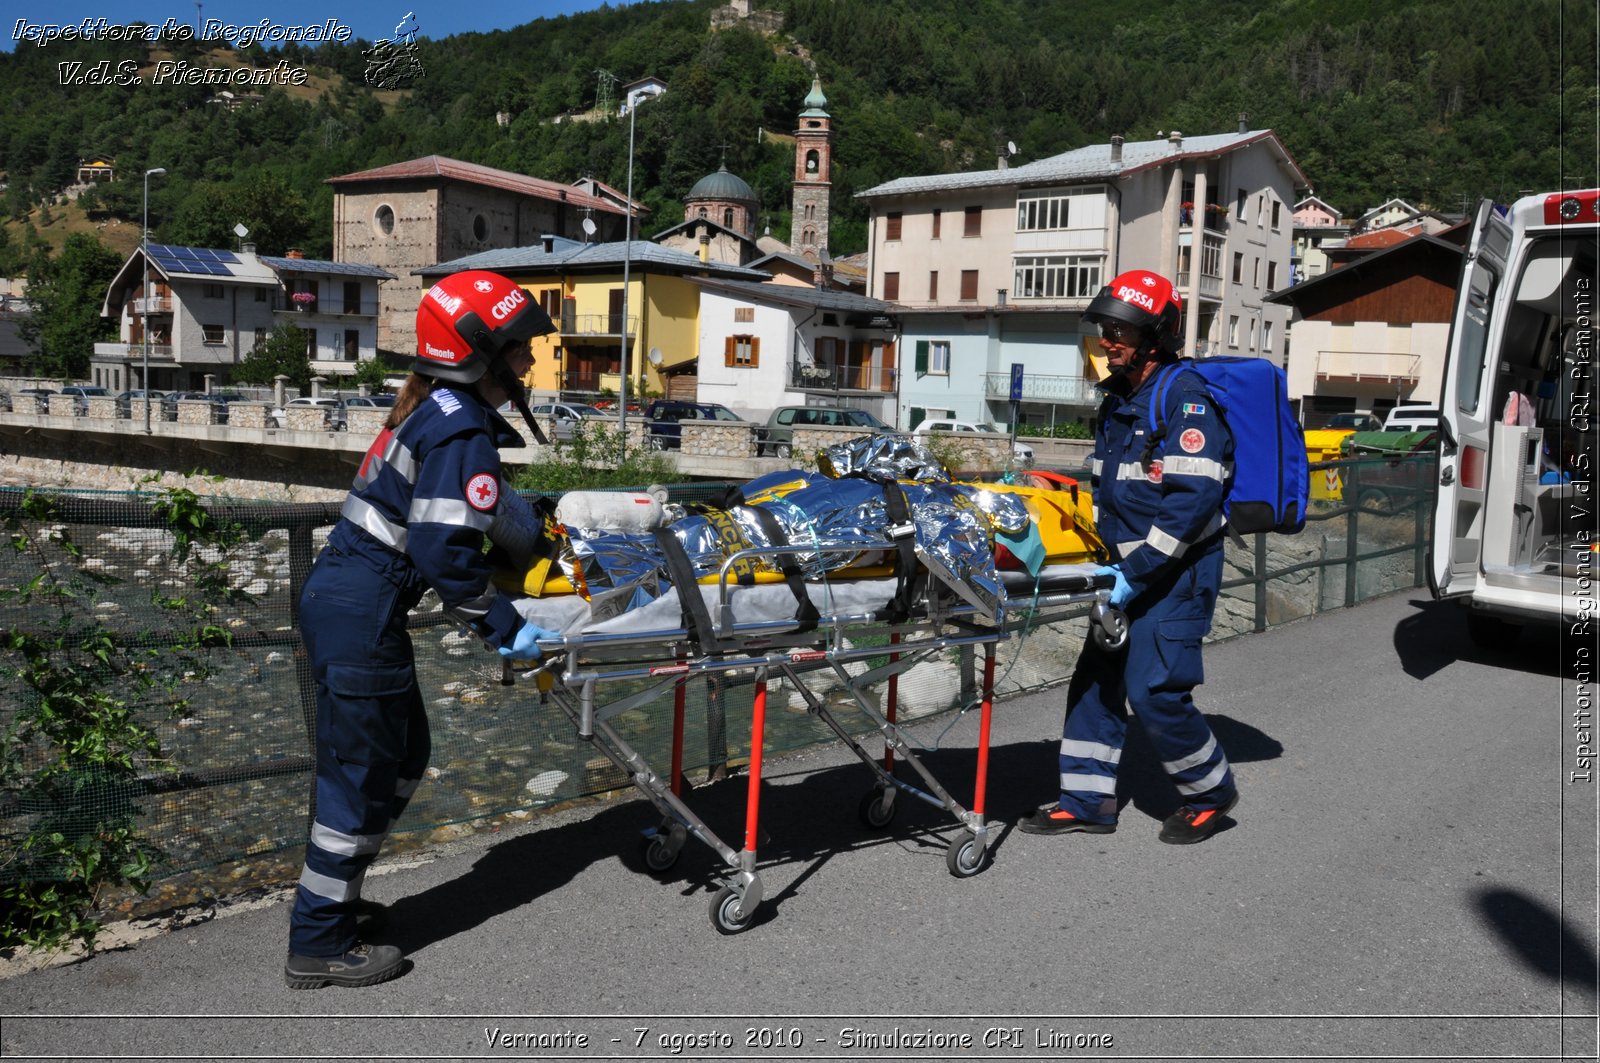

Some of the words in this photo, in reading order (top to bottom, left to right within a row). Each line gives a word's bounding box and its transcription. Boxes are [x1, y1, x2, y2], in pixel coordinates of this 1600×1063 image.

[1117, 285, 1154, 310] ROSSA
[425, 342, 455, 360] Piemonte
[1014, 365, 1022, 384] P
